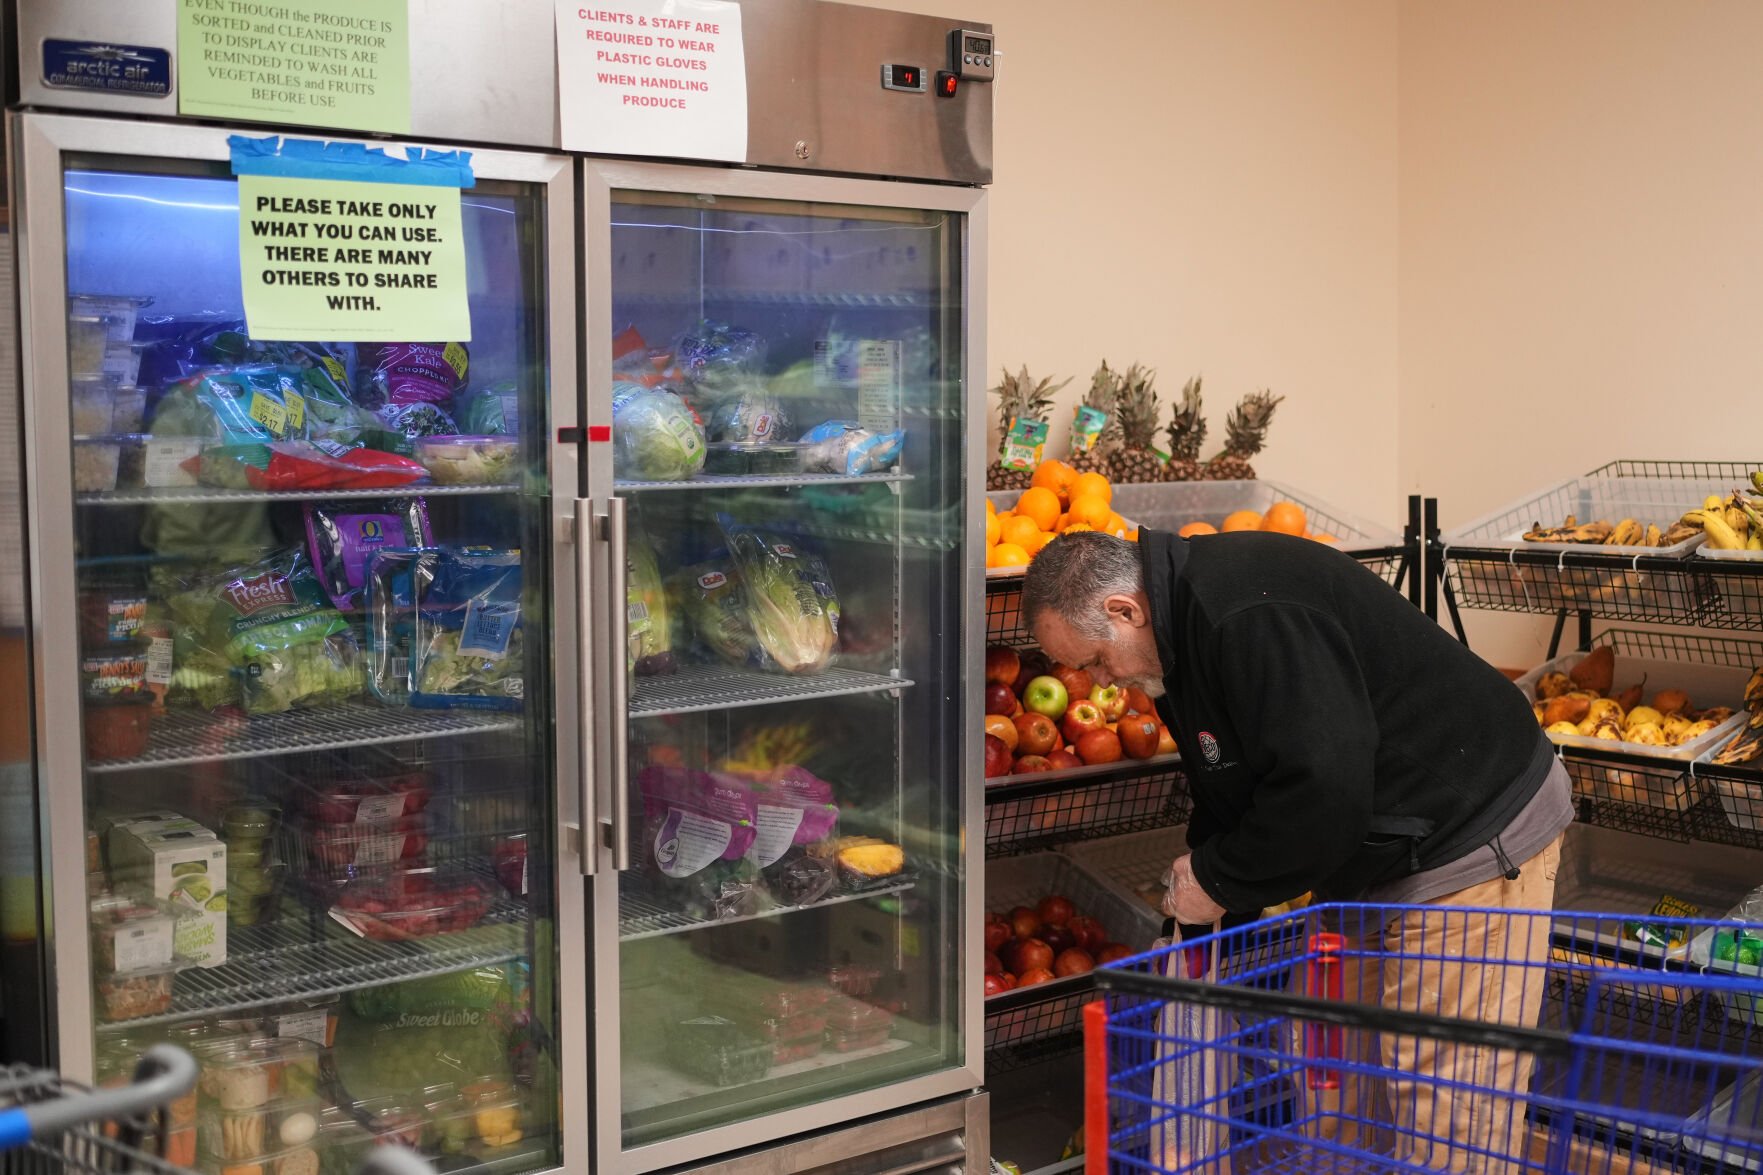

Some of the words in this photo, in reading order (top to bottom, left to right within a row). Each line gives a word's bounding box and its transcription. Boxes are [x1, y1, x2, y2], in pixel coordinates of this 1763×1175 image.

[185, 0, 224, 11] EVEN
[230, 1, 289, 20] THOUGH
[293, 12, 310, 22] the
[313, 13, 377, 32] PRODUCE
[381, 21, 392, 33] IS
[578, 8, 634, 25] CLIENTS
[638, 16, 647, 26] &
[651, 17, 691, 31] STAFF
[695, 22, 720, 34] ARE
[192, 14, 250, 32] SORTED
[253, 23, 275, 34] and
[278, 25, 343, 43] CLEANED
[346, 35, 386, 48] PRIOR
[586, 29, 653, 46] REQUIRED
[657, 37, 675, 48] TO
[678, 39, 715, 53] WEAR
[202, 31, 222, 45] TO
[226, 35, 287, 53] DISPLAY
[290, 43, 347, 61] CLIENTS
[351, 51, 378, 64] ARE
[67, 61, 120, 77] arctic
[124, 64, 149, 79] air
[204, 49, 281, 69] REMINDED
[285, 59, 304, 71] TO
[307, 62, 347, 76] WASH
[351, 67, 377, 80] ALL
[597, 50, 652, 66] PLASTIC
[656, 56, 707, 71] GLOVES
[207, 66, 301, 87] VEGETABLES
[304, 79, 325, 90] and
[328, 82, 375, 96] FRUITS
[597, 72, 636, 86] WHEN
[640, 76, 709, 92] HANDLING
[251, 88, 306, 105] BEFORE
[310, 95, 336, 108] USE
[622, 95, 687, 109] PRODUCE
[256, 196, 332, 215] PLEASE
[337, 200, 384, 217] TAKE
[388, 203, 437, 220] ONLY
[251, 220, 308, 238] WHAT
[313, 223, 353, 240] YOU
[358, 225, 396, 241] CAN
[401, 227, 443, 243] USE.
[264, 245, 329, 263] THERE
[333, 248, 373, 264] ARE
[378, 249, 432, 265] MANY
[262, 269, 341, 287] OTHERS
[345, 272, 369, 288] TO
[374, 273, 438, 289] SHARE
[326, 295, 381, 311] WITH.
[414, 354, 442, 369] Kale
[757, 415, 770, 433] Dole
[702, 573, 724, 587] Dole
[227, 577, 286, 604] Fresh
[242, 594, 287, 611] EXPRESS
[236, 612, 280, 630] CRUNCHY
[281, 603, 318, 618] BLENDS
[396, 1009, 441, 1028] Sweet
[442, 1008, 480, 1027] Globe
